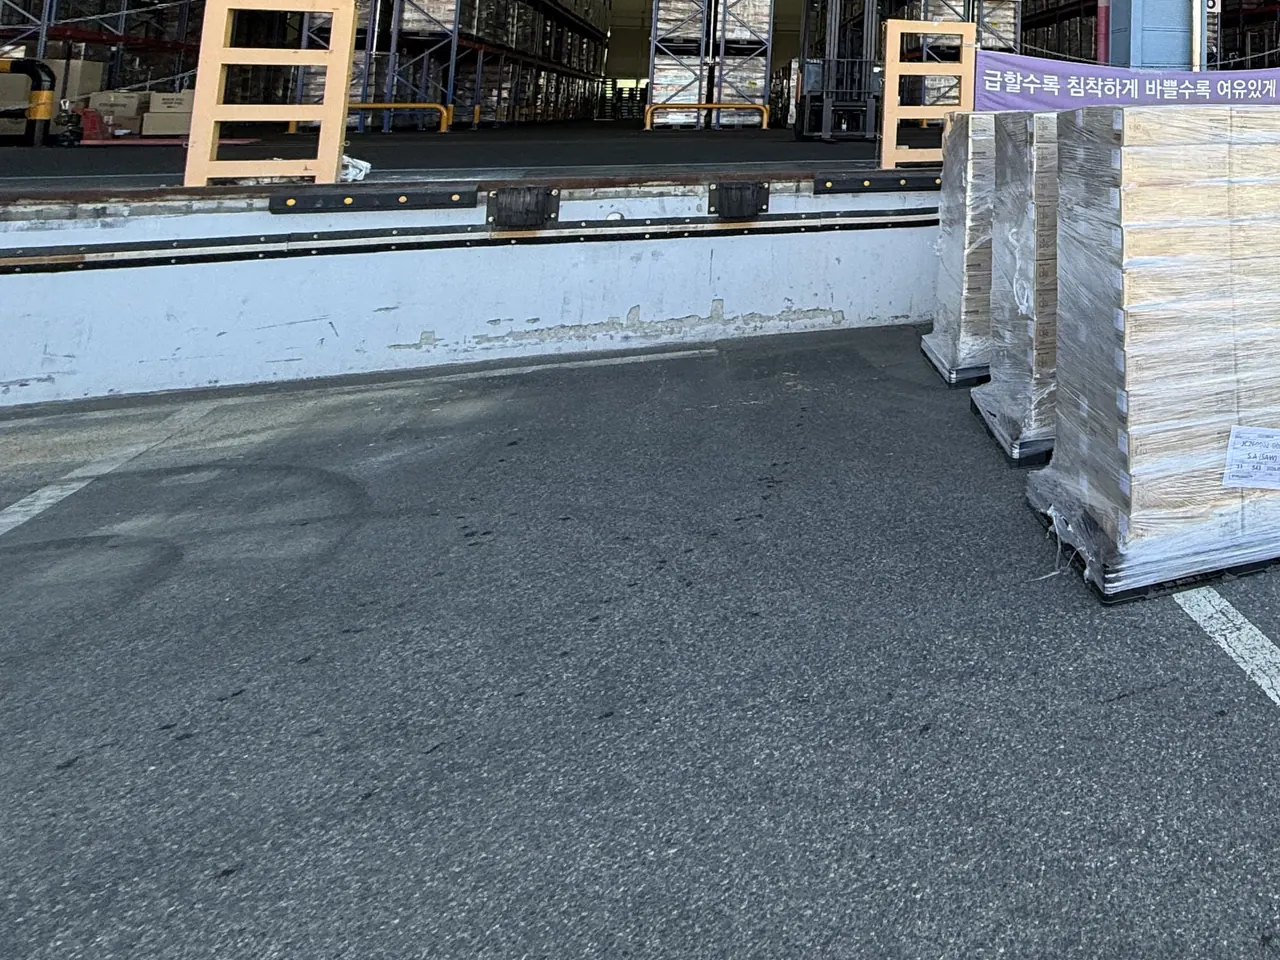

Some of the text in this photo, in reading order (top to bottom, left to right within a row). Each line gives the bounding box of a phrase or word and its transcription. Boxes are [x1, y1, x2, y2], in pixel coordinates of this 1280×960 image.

[983, 69, 1277, 100] 급할수록 침착하게 바쁠수록 여유있게
